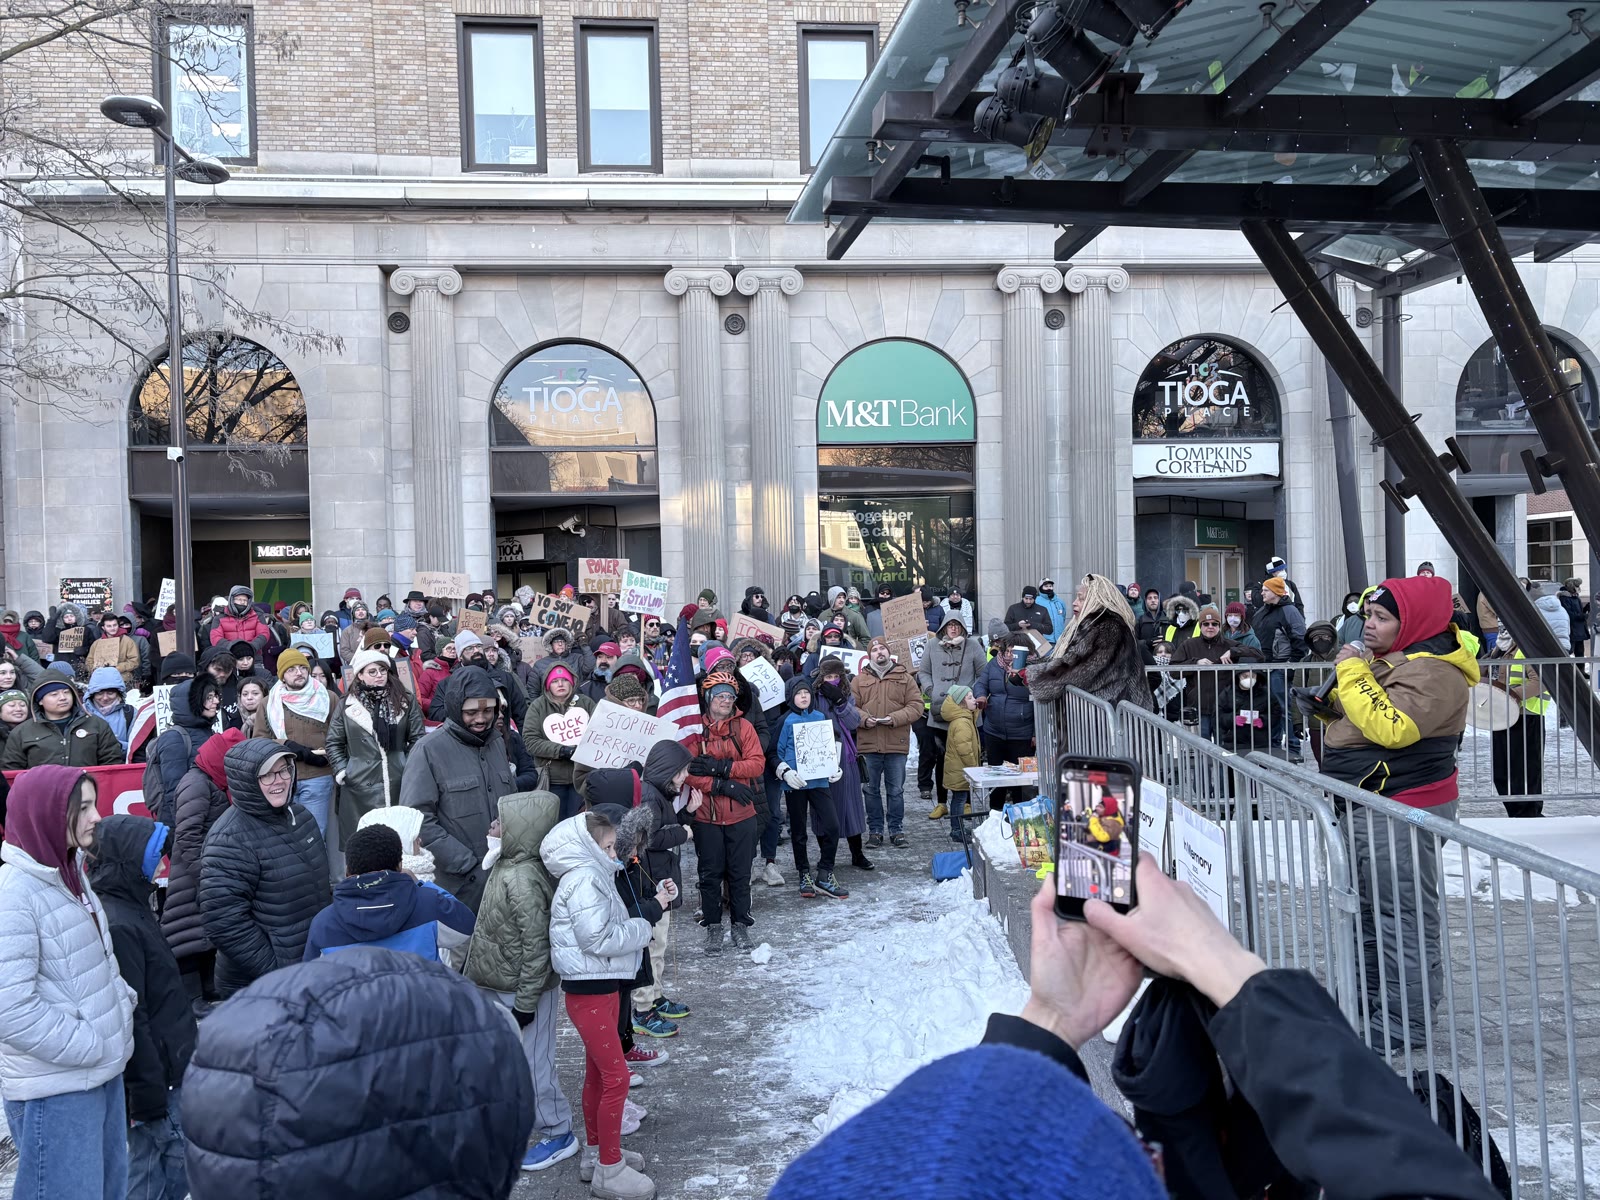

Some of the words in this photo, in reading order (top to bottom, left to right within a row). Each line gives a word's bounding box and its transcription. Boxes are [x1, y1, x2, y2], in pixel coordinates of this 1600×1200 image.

[522, 386, 622, 413] TIOGA
[1158, 380, 1250, 406] TIOGA
[530, 414, 623, 424] PLACE
[824, 399, 896, 428] M&T
[900, 398, 968, 427] Bank
[1165, 406, 1250, 416] PLACE
[1166, 446, 1252, 460] TOMPKINS
[1156, 458, 1246, 474] CORTLAND
[258, 546, 286, 557] M&T
[286, 546, 312, 557] Bank
[497, 544, 524, 556] TIOGA
[586, 558, 620, 577] POWER
[584, 578, 622, 592] PEOPLE
[537, 595, 550, 608] YO
[553, 600, 574, 614] SOY
[538, 609, 584, 632] CONEJO
[754, 664, 780, 696] Abolish
[550, 716, 584, 734] FUCK
[606, 712, 638, 732] STOP
[639, 721, 658, 736] THE
[559, 728, 582, 742] ICE
